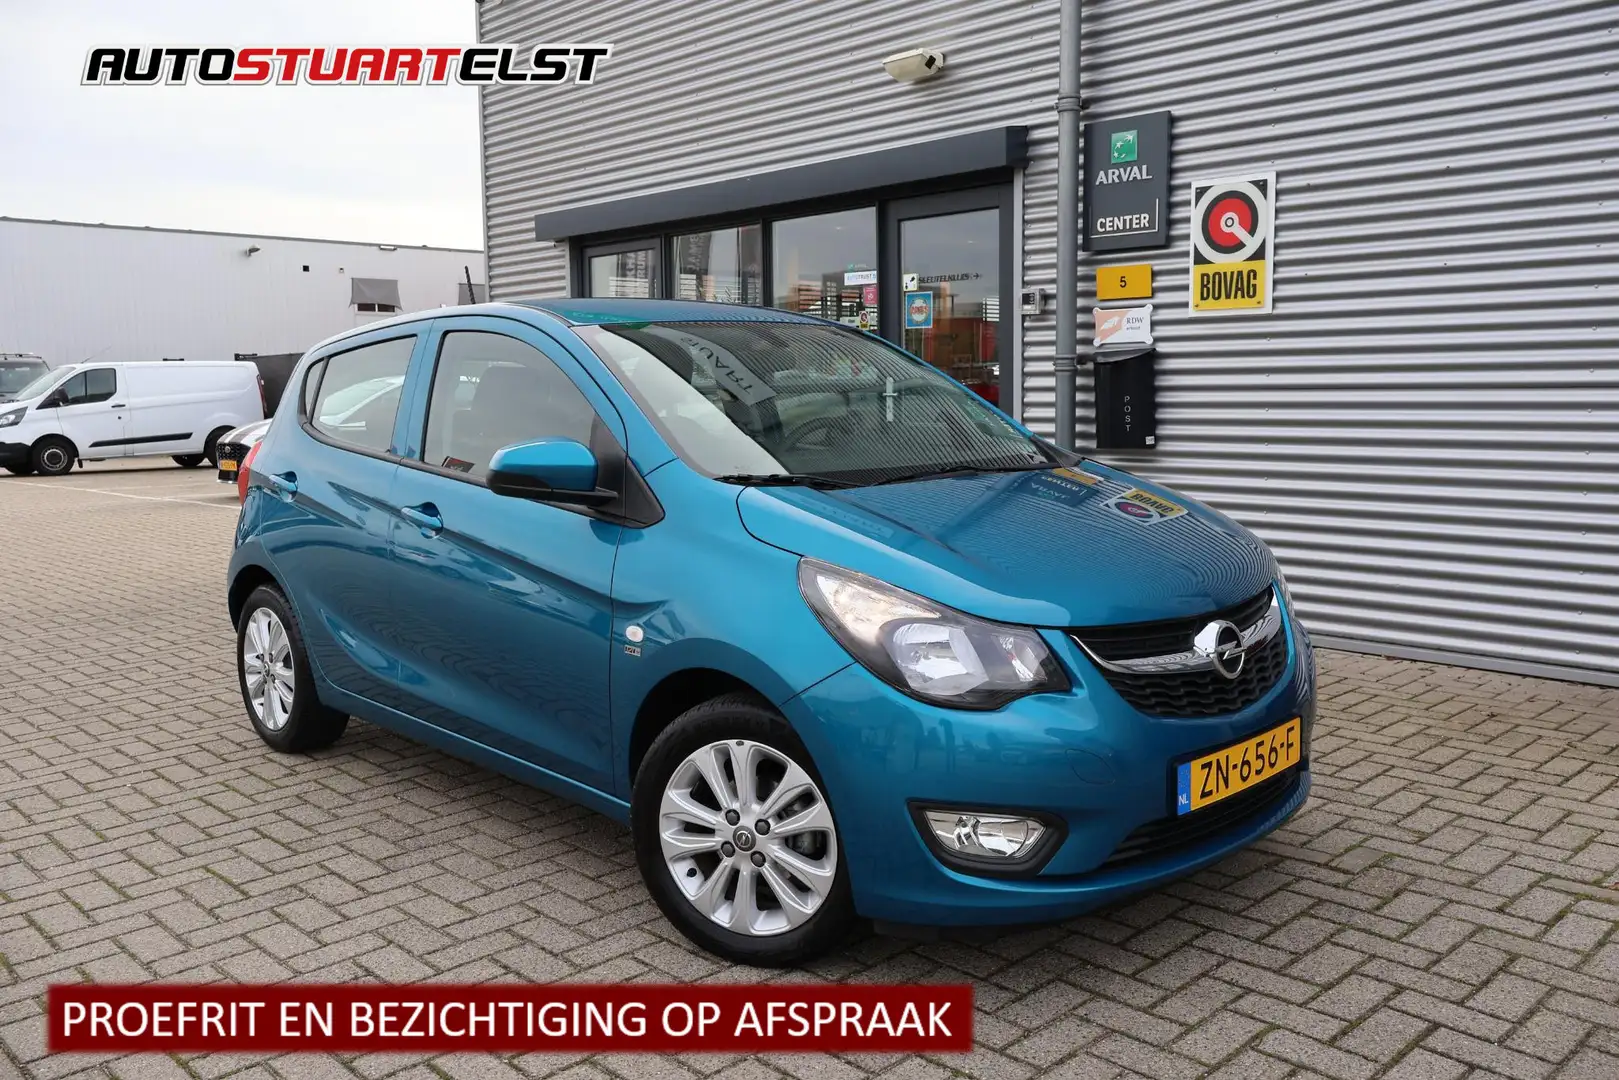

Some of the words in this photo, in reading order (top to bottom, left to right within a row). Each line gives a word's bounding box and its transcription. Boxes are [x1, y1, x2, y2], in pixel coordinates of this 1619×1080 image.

[1095, 164, 1152, 185] ARVAL
[1096, 213, 1150, 232] CENTER
[1119, 276, 1127, 289] 5
[1199, 268, 1258, 302] BOVAG
[1126, 316, 1144, 325] RDW
[1199, 725, 1296, 801] ZN-656-F
[1178, 794, 1189, 806] NL
